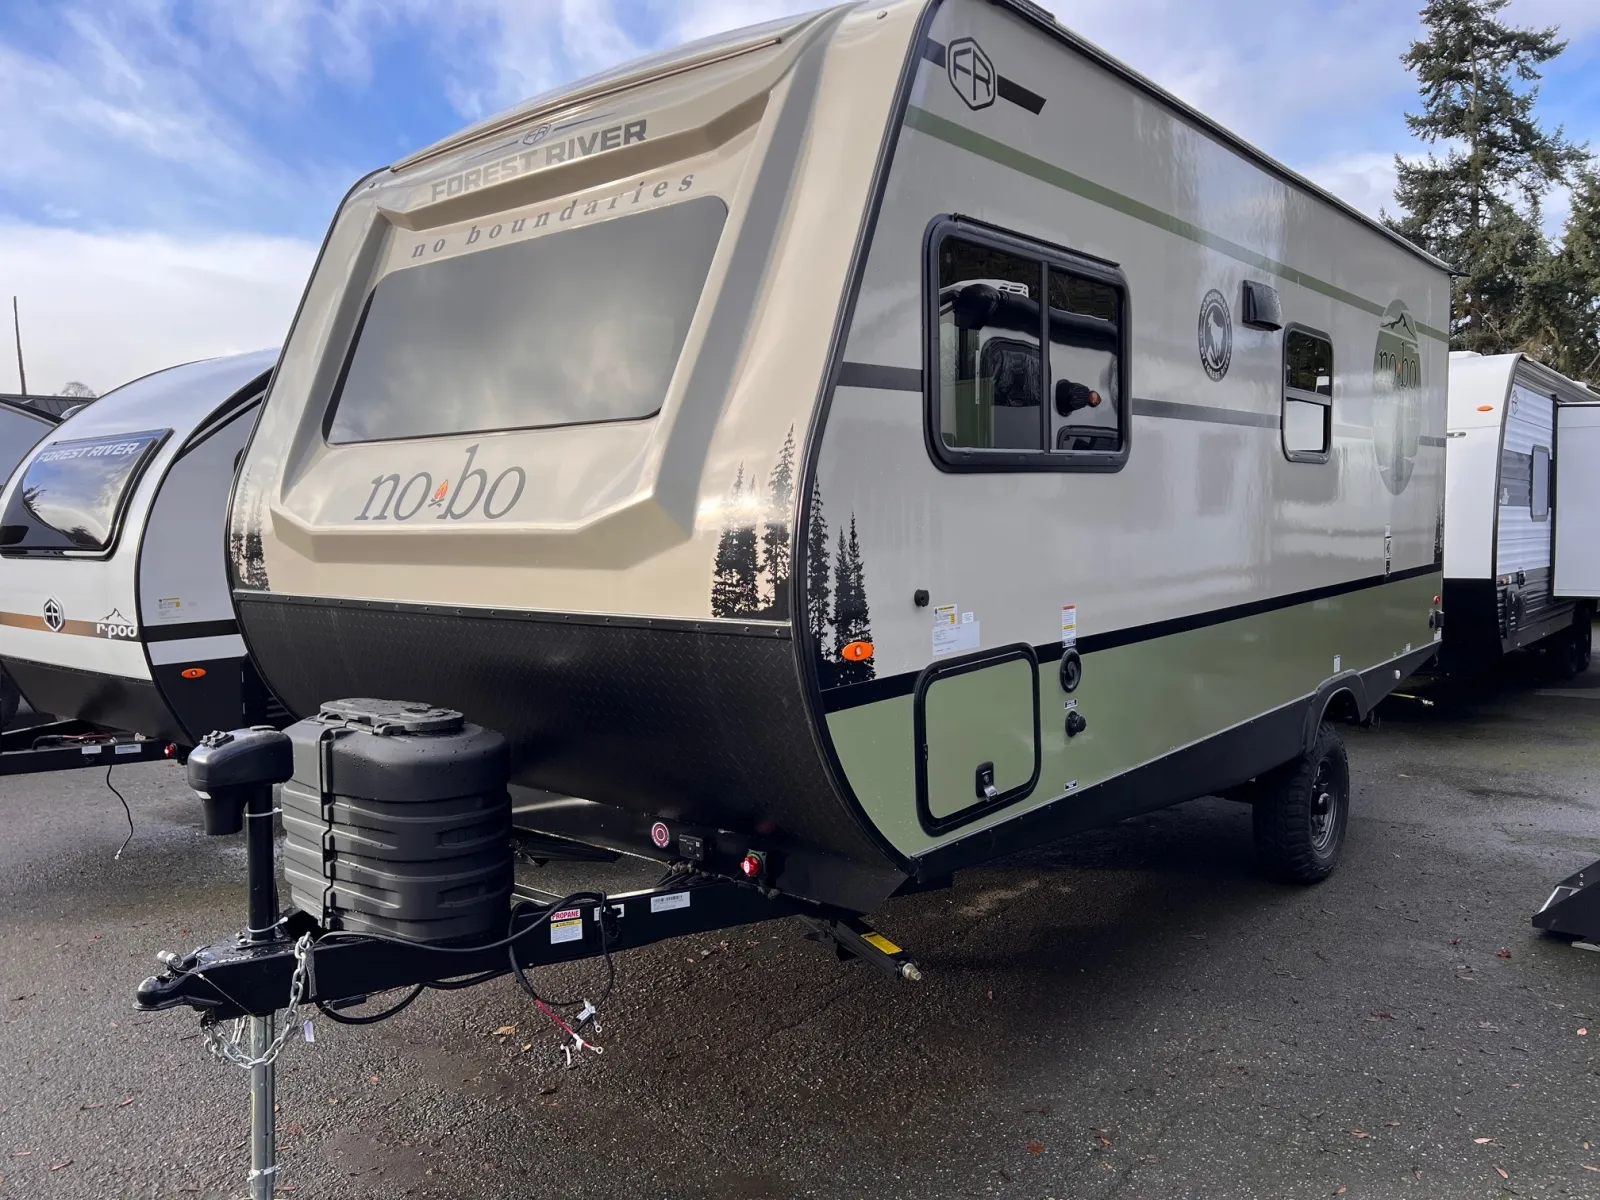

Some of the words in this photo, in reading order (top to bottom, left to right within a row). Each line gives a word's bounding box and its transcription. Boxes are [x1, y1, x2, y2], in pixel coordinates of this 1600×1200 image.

[431, 150, 539, 202] FOREST
[545, 119, 647, 166] RIVER
[411, 237, 446, 259] no
[465, 173, 695, 246] boundaries
[36, 447, 92, 463] FOREST
[88, 442, 140, 457] RIVER
[552, 910, 579, 920] PROPANE
